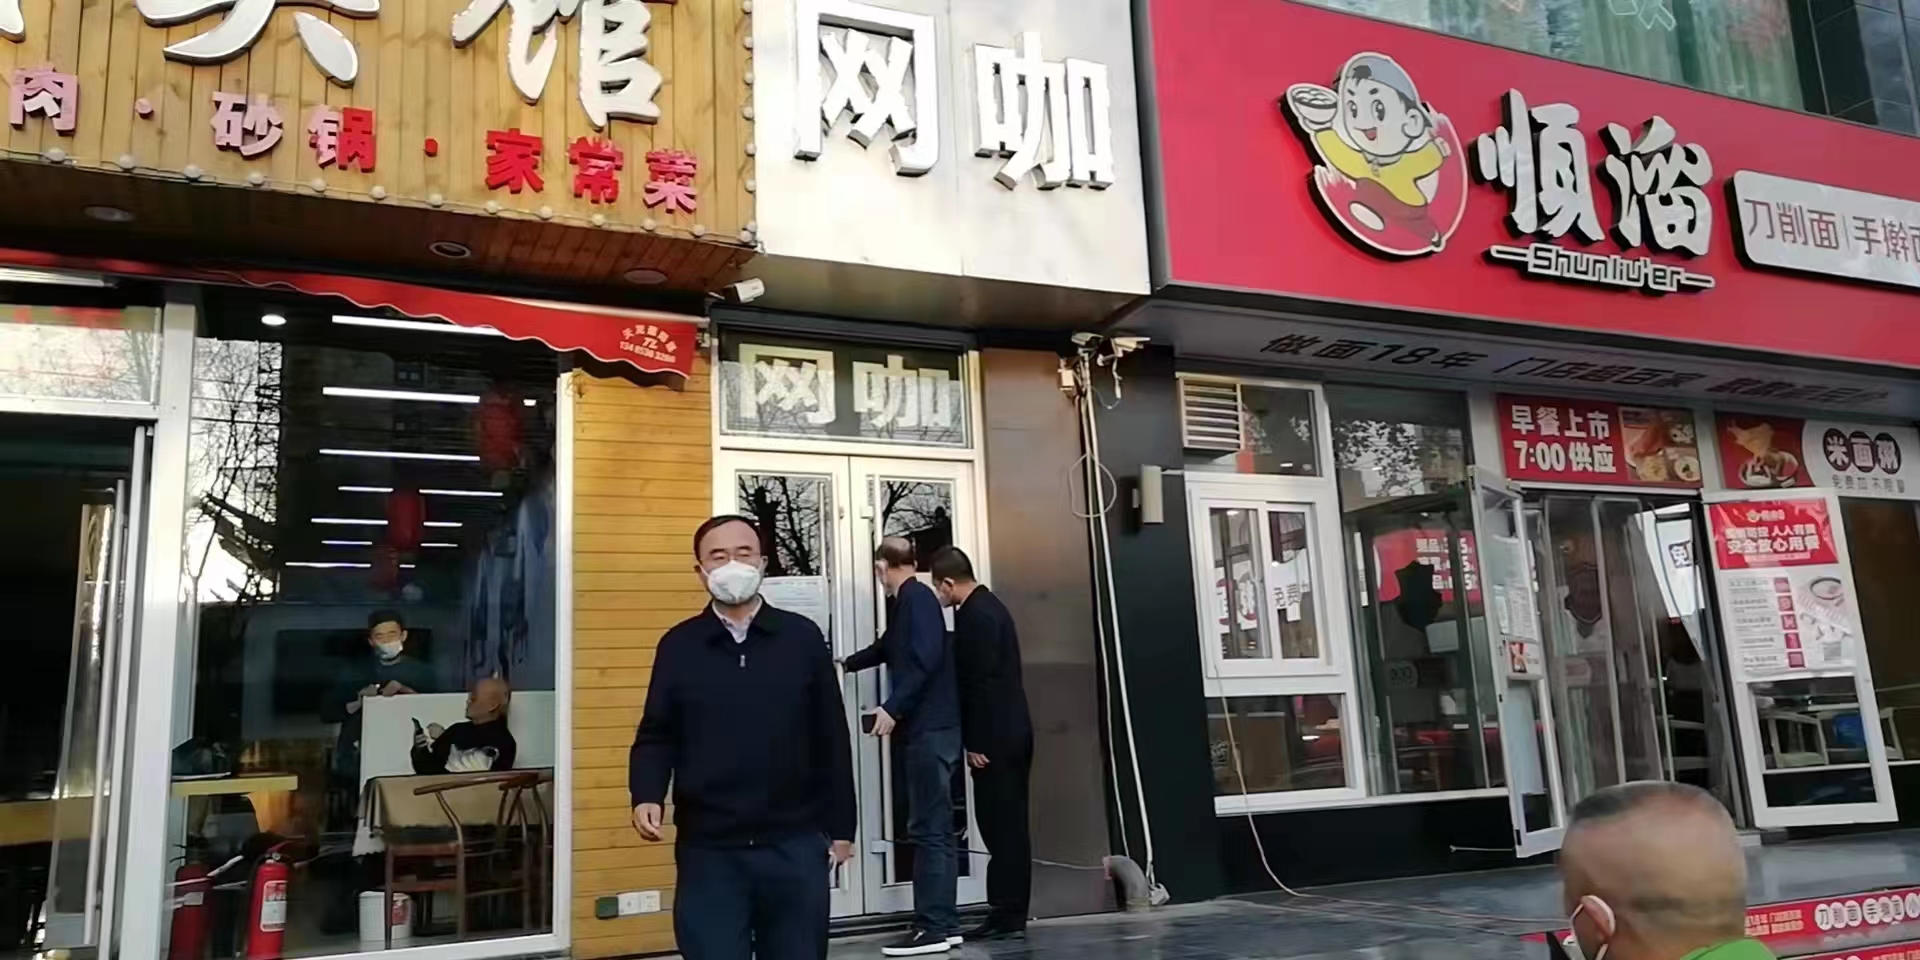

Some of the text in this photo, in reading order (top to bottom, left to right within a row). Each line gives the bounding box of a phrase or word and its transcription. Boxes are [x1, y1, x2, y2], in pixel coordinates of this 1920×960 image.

[793, 0, 1115, 191] 网咖
[1744, 198, 1840, 251] 刀削面
[738, 342, 951, 429] 网咖
[1511, 405, 1610, 440] 早餐上市
[1512, 440, 1617, 473] 7:00 供应
